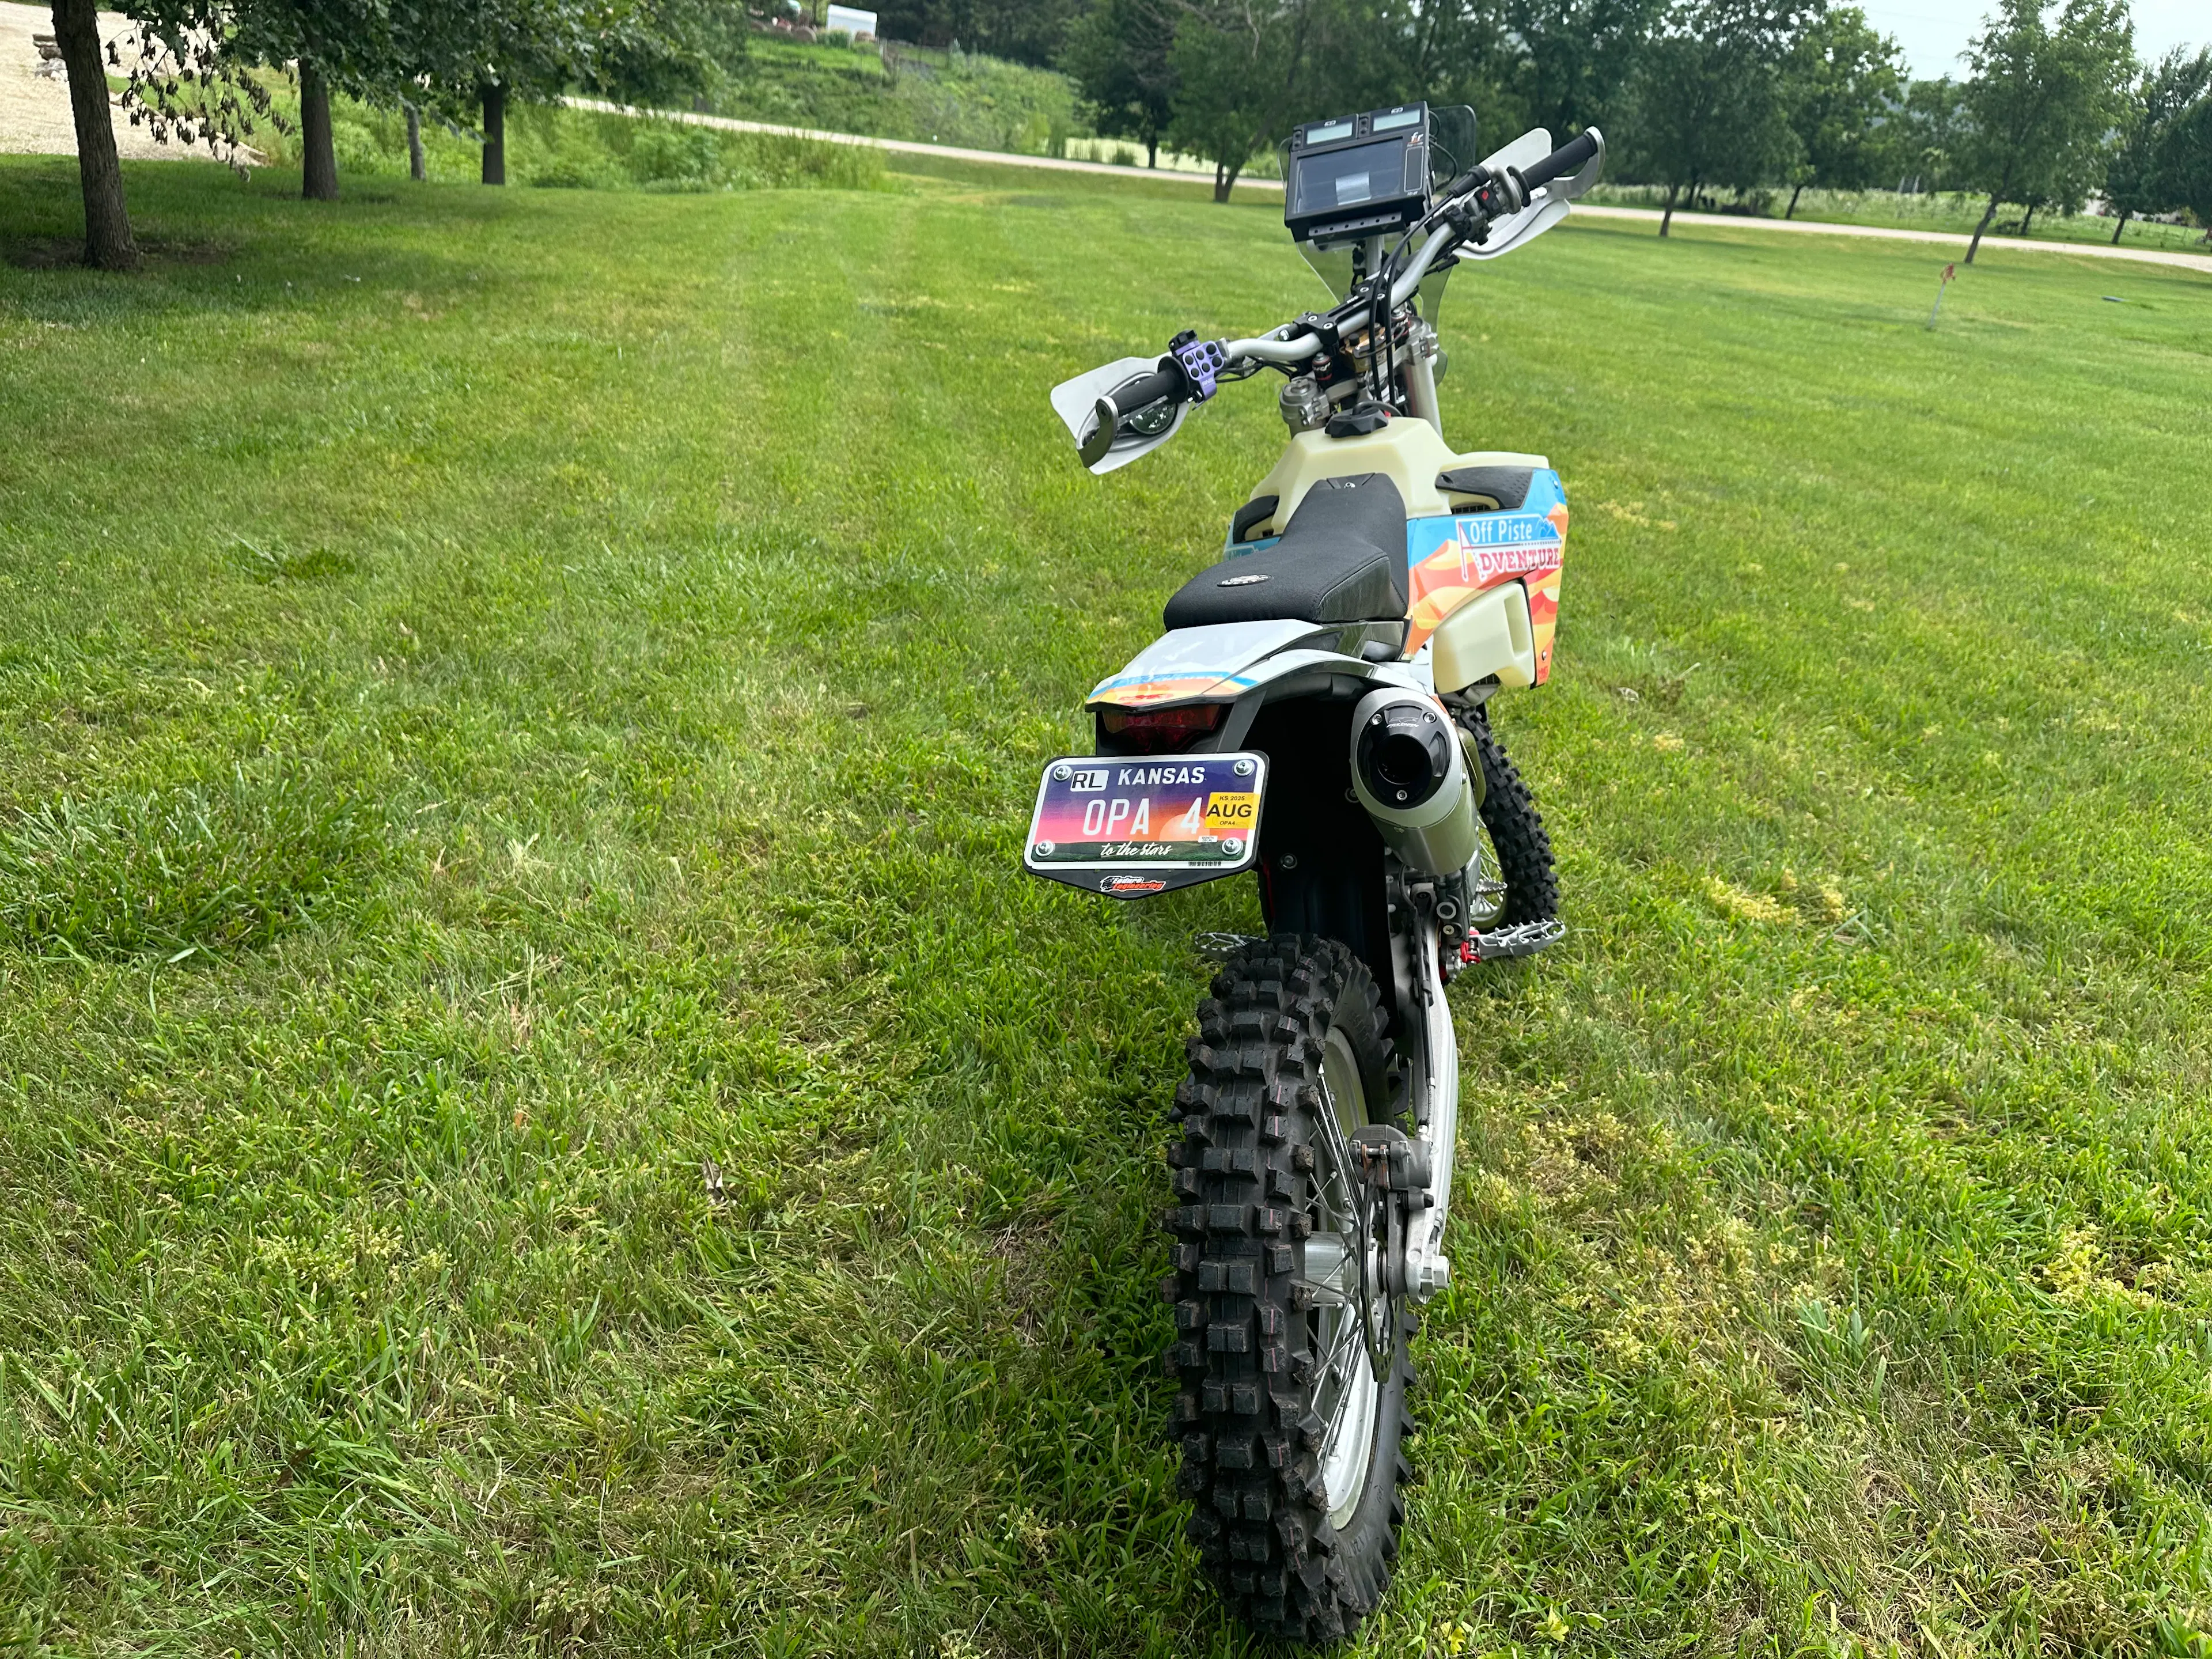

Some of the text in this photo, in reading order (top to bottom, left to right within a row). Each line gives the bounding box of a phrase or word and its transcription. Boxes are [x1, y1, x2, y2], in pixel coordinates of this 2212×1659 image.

[1470, 520, 1533, 544] Off Piste
[1071, 767, 1206, 789] RL KANSAS
[1082, 797, 1203, 835] OPA 4
[1206, 804, 1252, 817] AUG
[1100, 841, 1173, 856] to the stars
